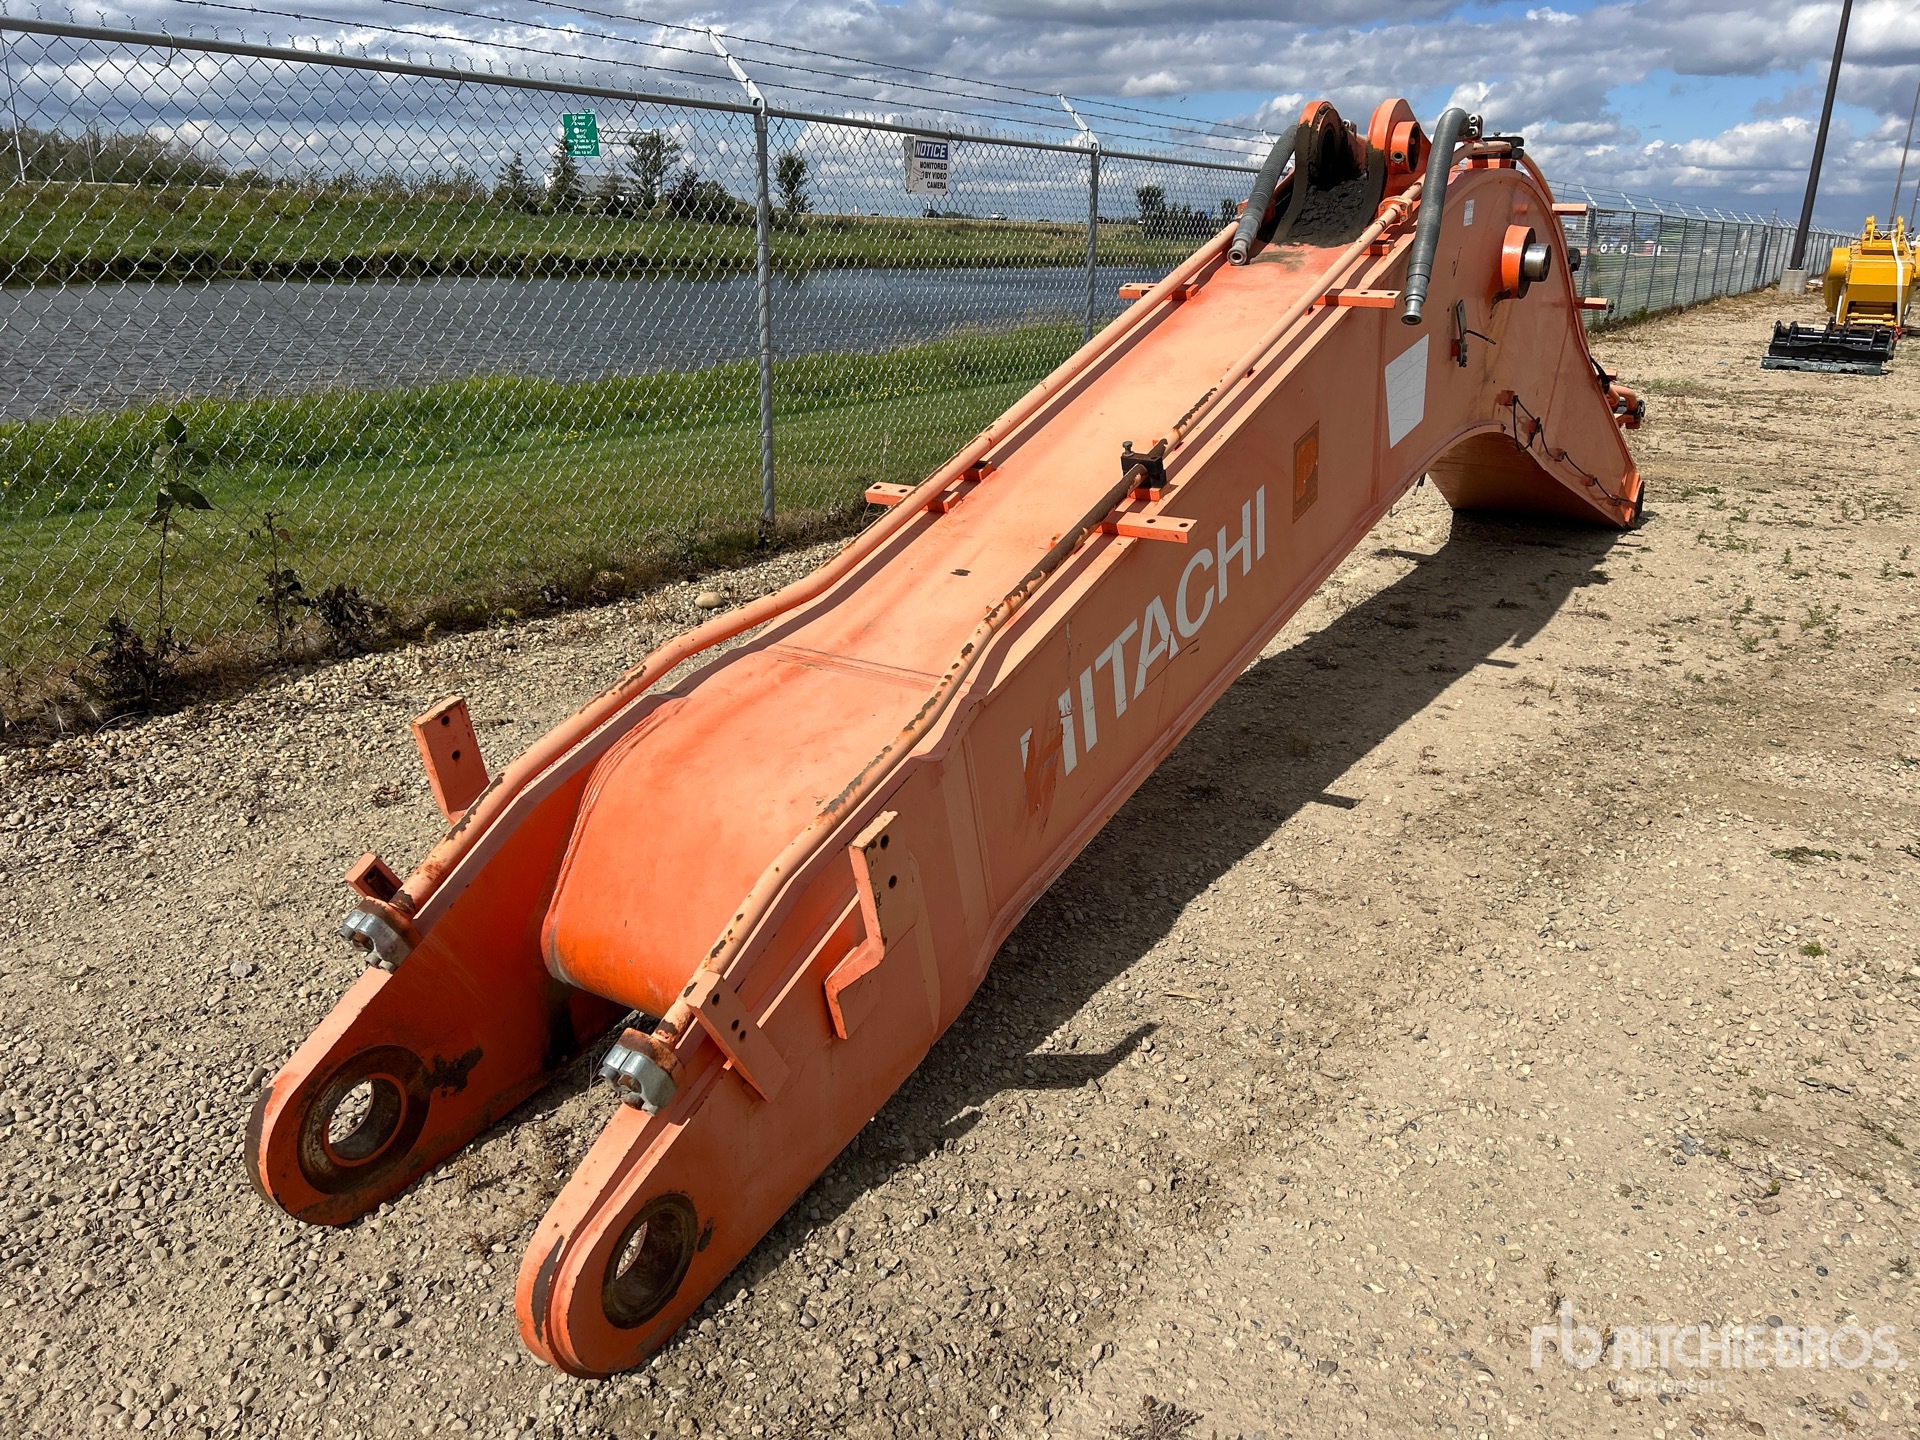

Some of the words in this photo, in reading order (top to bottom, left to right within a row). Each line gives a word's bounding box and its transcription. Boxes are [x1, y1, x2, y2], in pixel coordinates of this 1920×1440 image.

[915, 142, 946, 158] NOTICE
[920, 161, 947, 170] MONITORED
[932, 172, 947, 180] VIDEO
[927, 181, 946, 189] CAMERA
[1019, 484, 1265, 812] HITACHI
